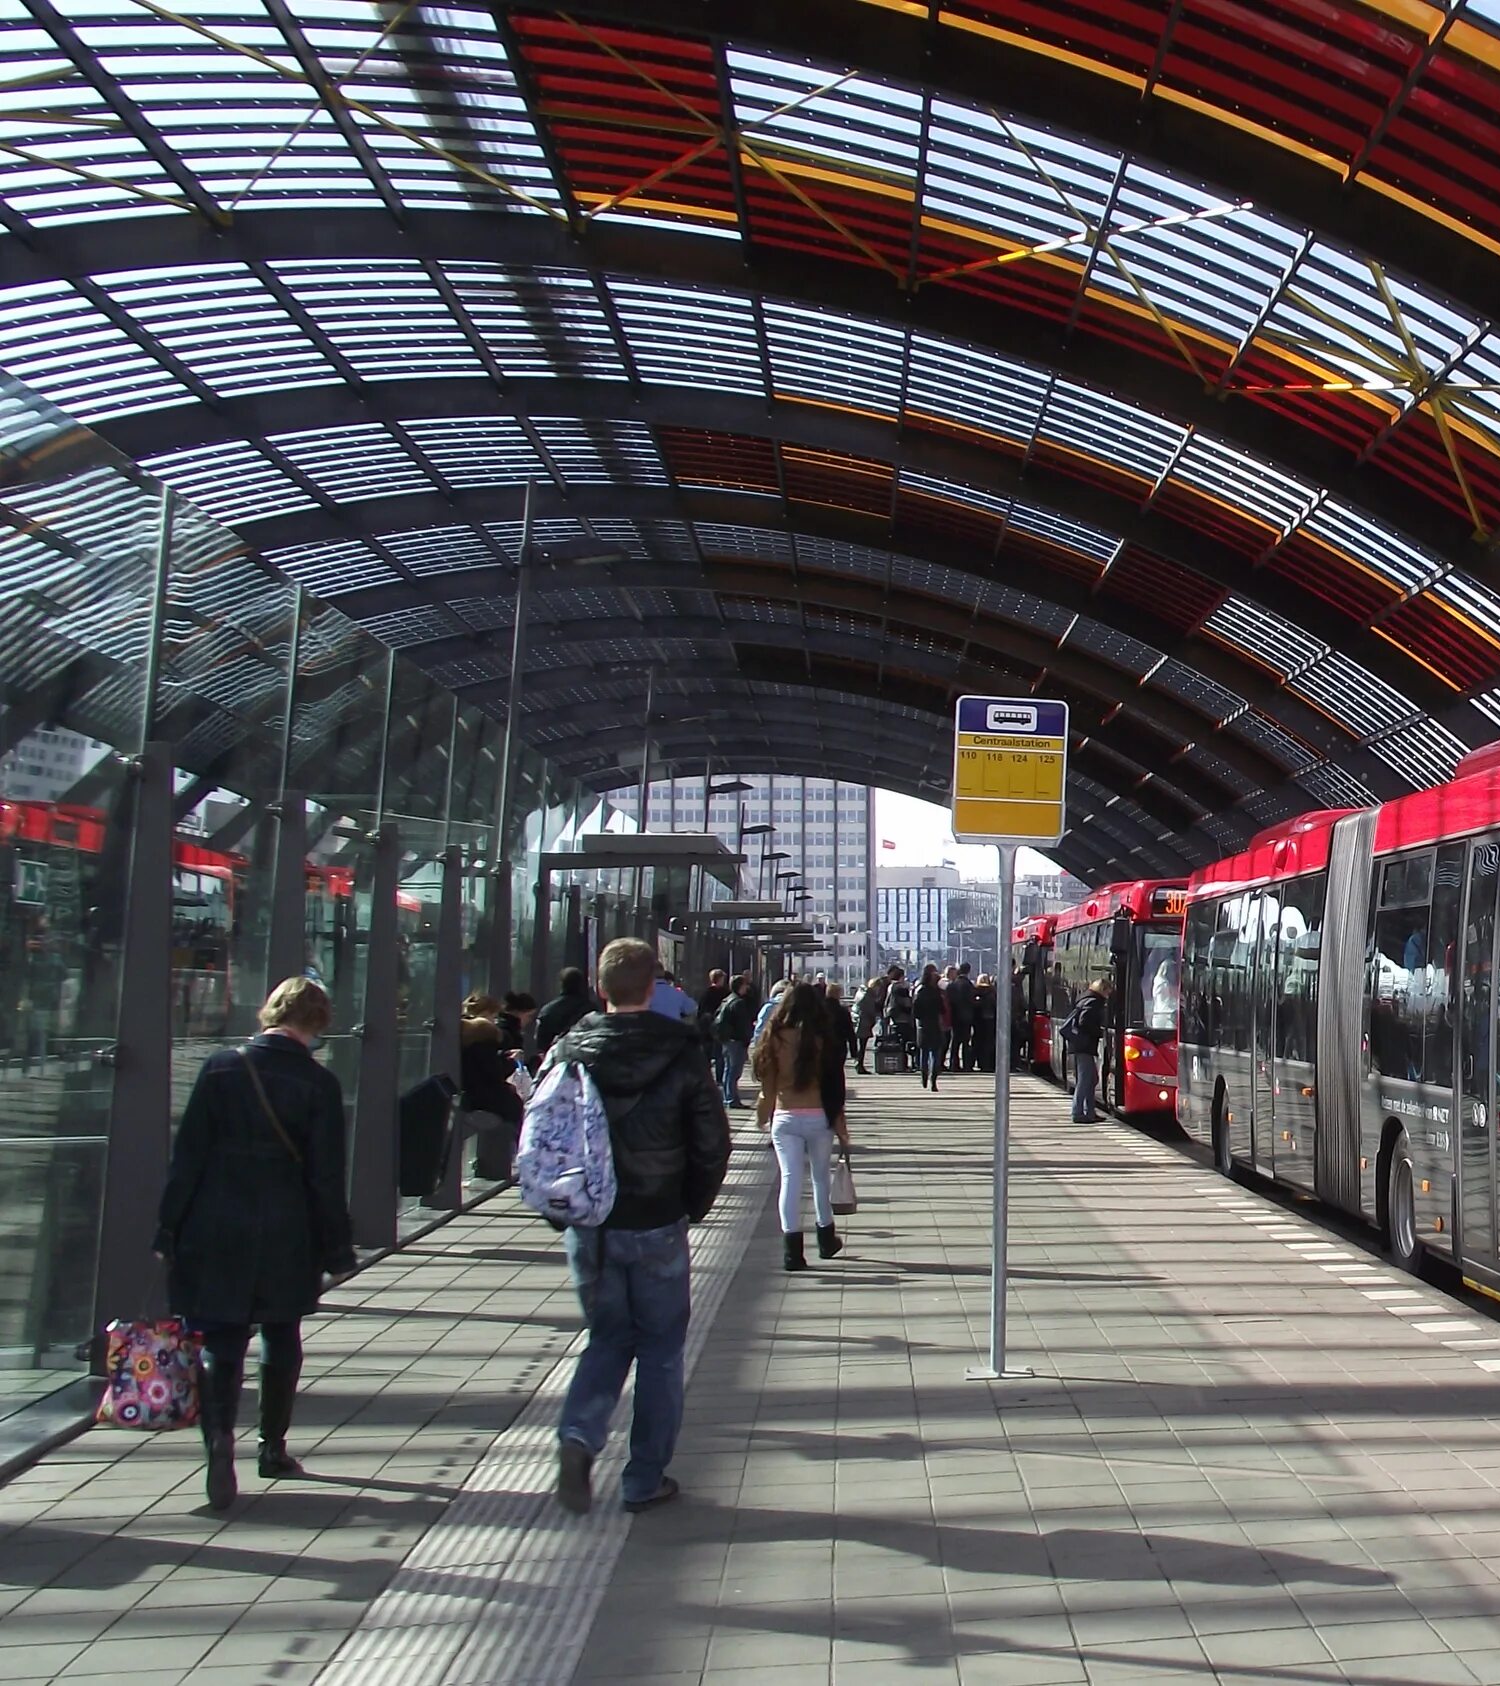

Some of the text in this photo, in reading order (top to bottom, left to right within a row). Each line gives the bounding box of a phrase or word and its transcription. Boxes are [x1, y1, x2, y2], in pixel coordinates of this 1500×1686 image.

[973, 735, 1051, 748] Centraalstation
[961, 751, 1055, 764] 110 118 124 125
